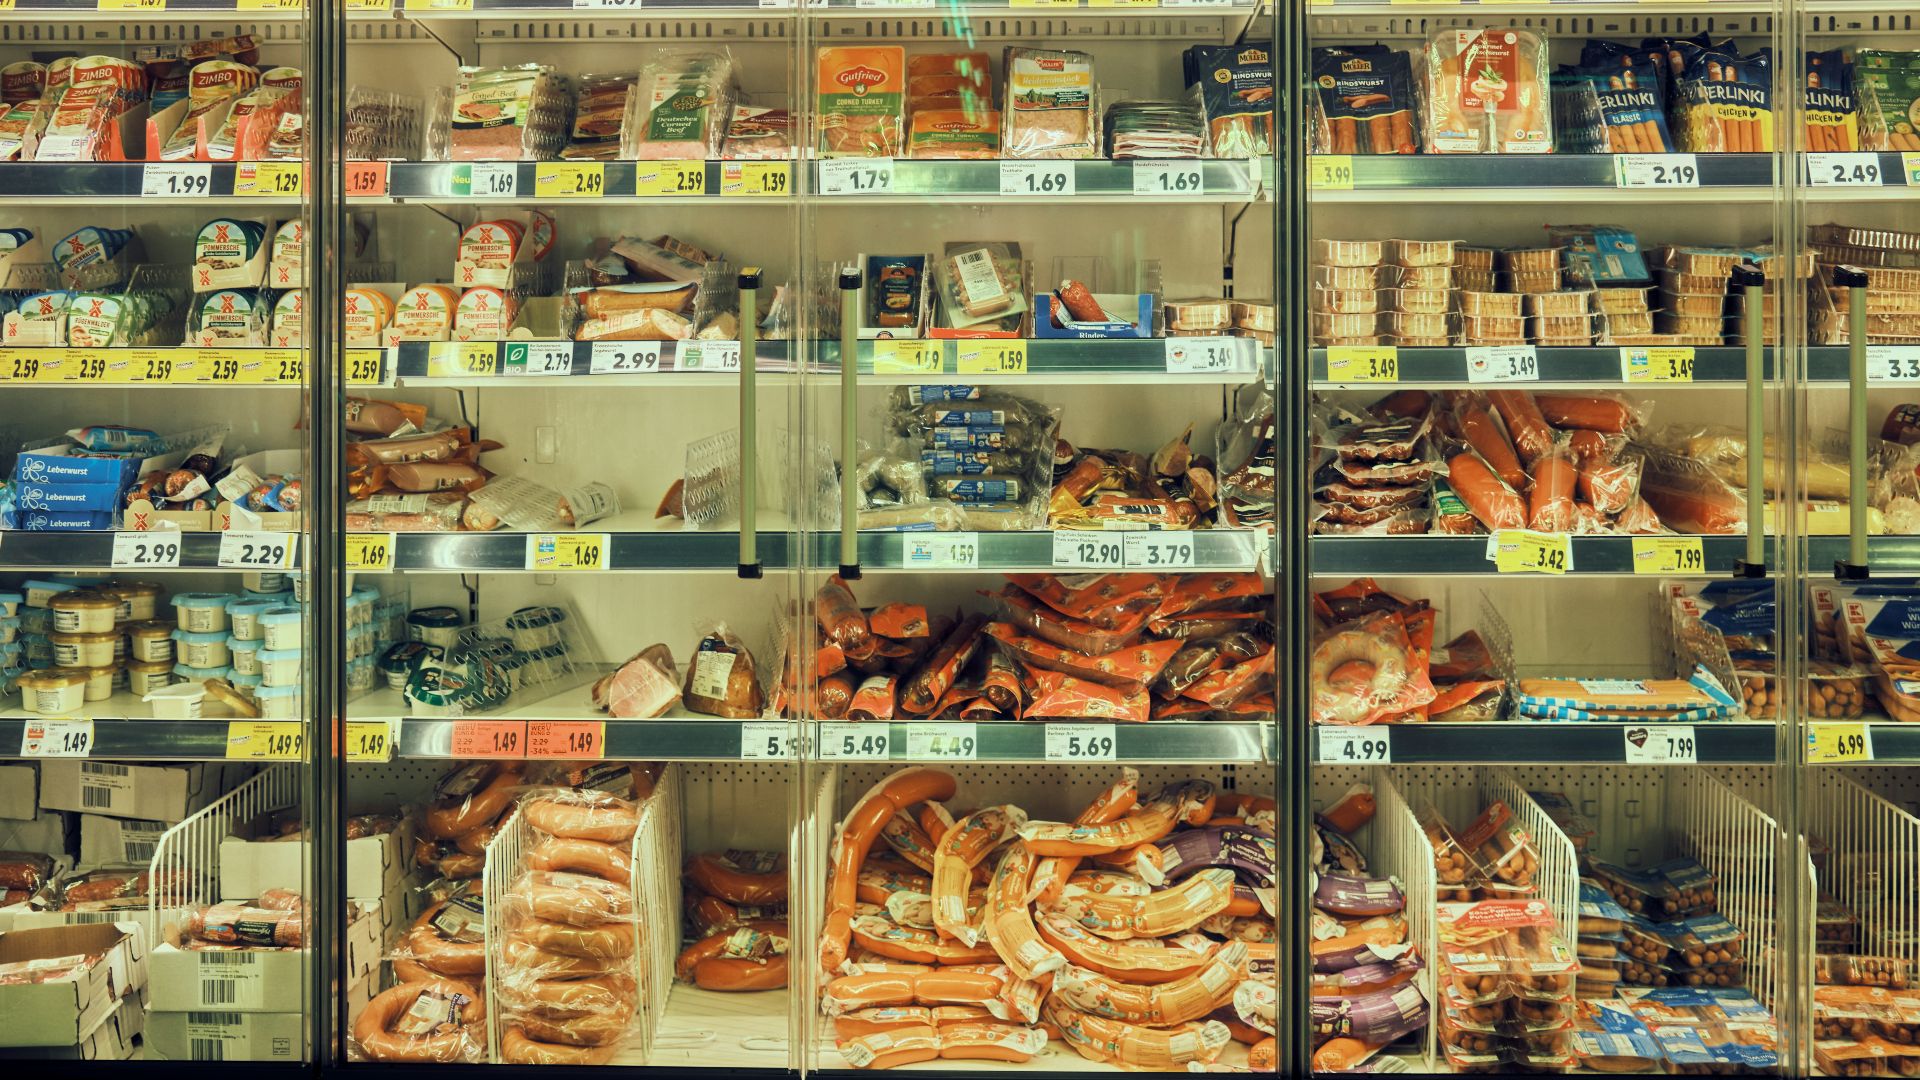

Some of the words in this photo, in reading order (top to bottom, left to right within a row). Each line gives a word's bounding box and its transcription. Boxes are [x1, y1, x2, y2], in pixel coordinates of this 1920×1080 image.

[1239, 54, 1267, 63] MÜLLER
[1343, 62, 1370, 71] MÜLLER
[8, 73, 39, 87] ZIMBO
[79, 68, 113, 82] ZIMBO
[198, 72, 232, 85] ZIMBO
[840, 69, 882, 83] Gutfried
[1336, 79, 1384, 87] RINDSWURST
[72, 86, 107, 97] ZIMBO
[1598, 92, 1655, 109] ERLINKI
[836, 98, 859, 106] CORNED
[1612, 113, 1641, 123] CLASSIC
[1718, 108, 1748, 117] CHICKEN
[275, 173, 299, 192] 1.29
[353, 171, 376, 190] 1.59
[452, 175, 471, 184] Neu
[490, 173, 513, 193] 1.69
[576, 173, 601, 192] 2.49
[677, 171, 702, 191] 2.59
[762, 172, 785, 192] 1.39
[850, 169, 890, 189] 1.79
[1025, 173, 1067, 192] 1.69
[1159, 172, 1200, 191] 1.69
[1324, 166, 1350, 184] 3.99
[1653, 165, 1694, 184] 2.19
[1832, 165, 1877, 183] 2.49
[168, 175, 208, 193] 1.99
[468, 244, 504, 252] POMMERSCHE
[403, 311, 439, 319] POMMERSCHE
[468, 353, 493, 372] 2.59
[544, 352, 570, 371] 2.79
[613, 352, 657, 369] 2.99
[722, 352, 741, 368] 1.5
[915, 350, 939, 369] 159
[998, 350, 1022, 369] 1.59
[1207, 347, 1232, 367] 3.49
[1508, 355, 1535, 375] 3.49
[13, 359, 39, 378] 2.59
[79, 359, 106, 378] 2.59
[146, 360, 171, 379] 2.59
[212, 360, 238, 379] 2.59
[279, 360, 302, 380] 2.59
[352, 360, 377, 379] 2.59
[506, 366, 522, 374] BIO
[1369, 358, 1395, 378] 3.49
[1668, 358, 1694, 378] 3.49
[1888, 359, 1920, 378] 3.3
[47, 465, 88, 475] Leberwurst
[46, 493, 86, 501] Leberwurst
[50, 519, 91, 527] Leberwurst
[134, 544, 177, 563] 2.99
[240, 544, 284, 564] 2.29
[361, 545, 385, 565] 1.69
[575, 545, 599, 565] 1.69
[950, 544, 974, 564] 1.59
[1077, 543, 1120, 564] 12.90
[1146, 544, 1190, 564] 3.79
[1537, 547, 1564, 570] 3.42
[1674, 549, 1700, 569] 7.99
[63, 732, 88, 752] 1.49
[268, 734, 291, 754] 1.49
[360, 734, 384, 755] 1.49
[493, 732, 517, 752] 1.49
[569, 732, 593, 752] 1.49
[843, 735, 887, 755] 5.49
[930, 736, 974, 756] 4.49
[1068, 737, 1112, 756] 5.69
[1343, 740, 1387, 760] 4.99
[1667, 738, 1692, 758] 7.99
[1838, 734, 1863, 755] 6.99
